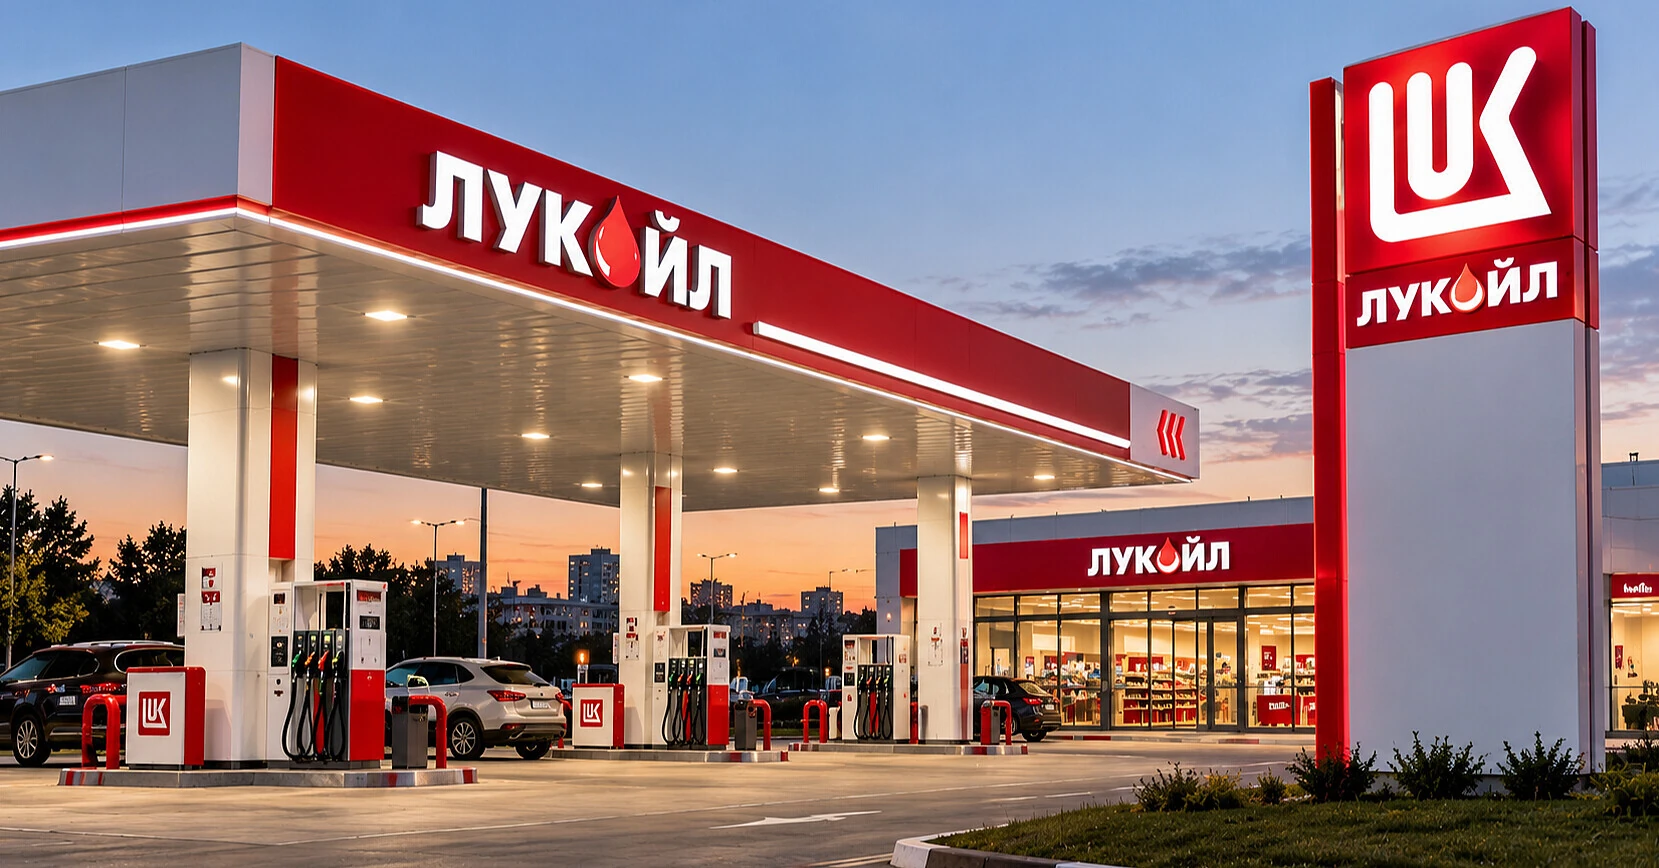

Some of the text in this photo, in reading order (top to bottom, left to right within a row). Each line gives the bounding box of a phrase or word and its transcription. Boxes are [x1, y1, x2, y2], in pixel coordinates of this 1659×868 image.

[416, 150, 732, 319] ЛУКОЙЛ
[1356, 257, 1558, 327] ЛУКОЙЛ
[1087, 535, 1230, 577] ЛУКОЙЛ
